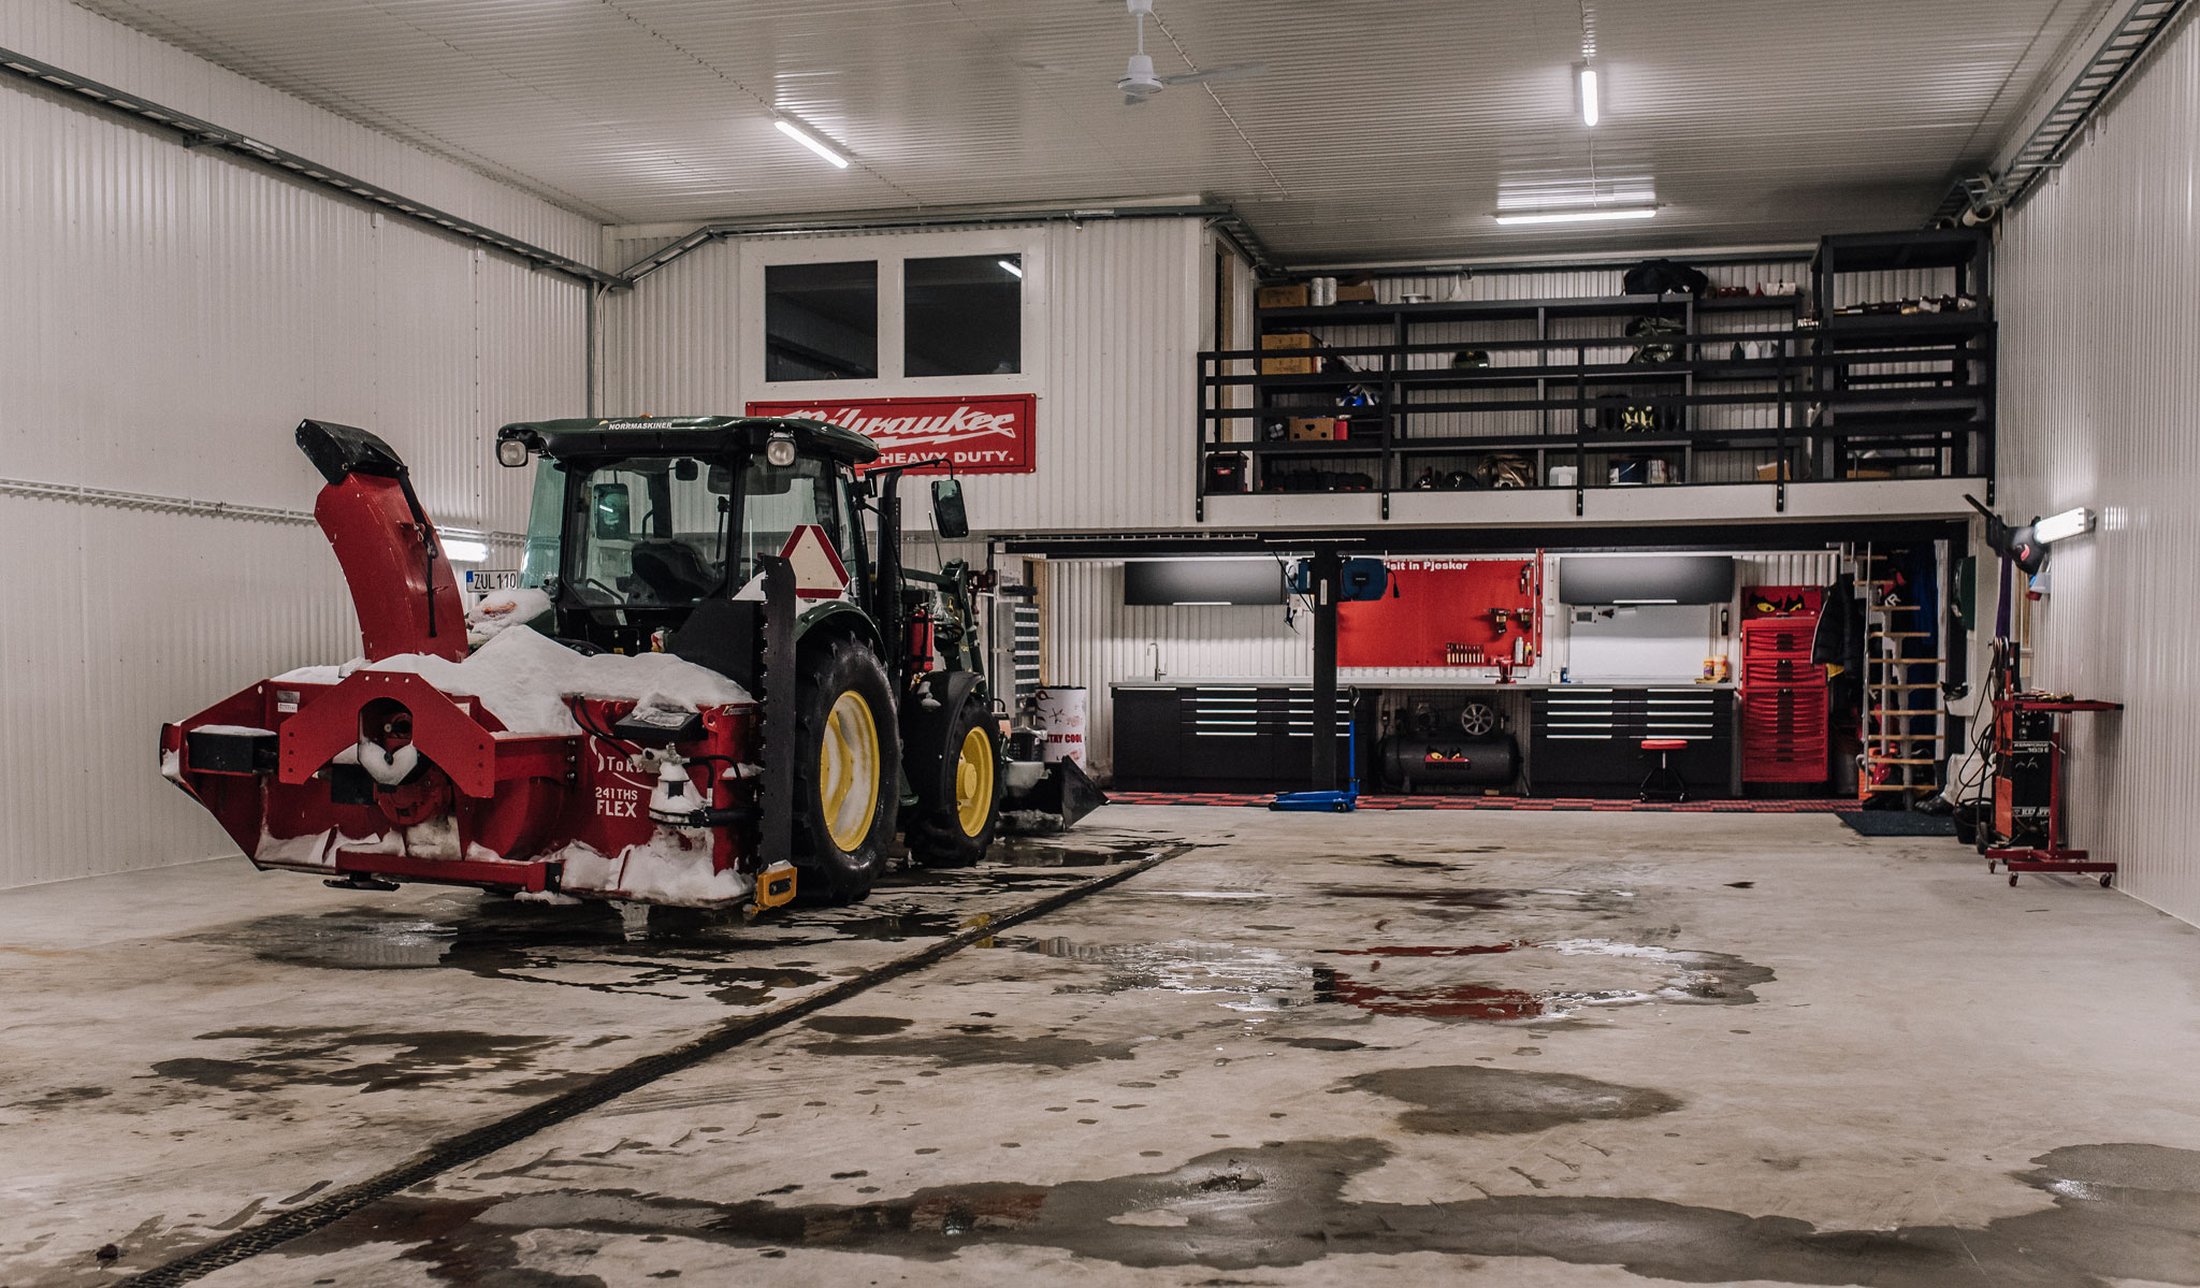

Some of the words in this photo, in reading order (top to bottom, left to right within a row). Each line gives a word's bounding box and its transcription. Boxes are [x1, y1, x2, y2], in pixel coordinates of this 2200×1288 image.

[608, 422, 673, 431] NORRMASKINER
[880, 452, 948, 464] HEAVY
[954, 451, 1015, 463] DUTY.
[474, 573, 496, 590] ZUL
[496, 573, 517, 589] 110
[595, 786, 638, 801] 241THS
[596, 800, 637, 818] FLEX
